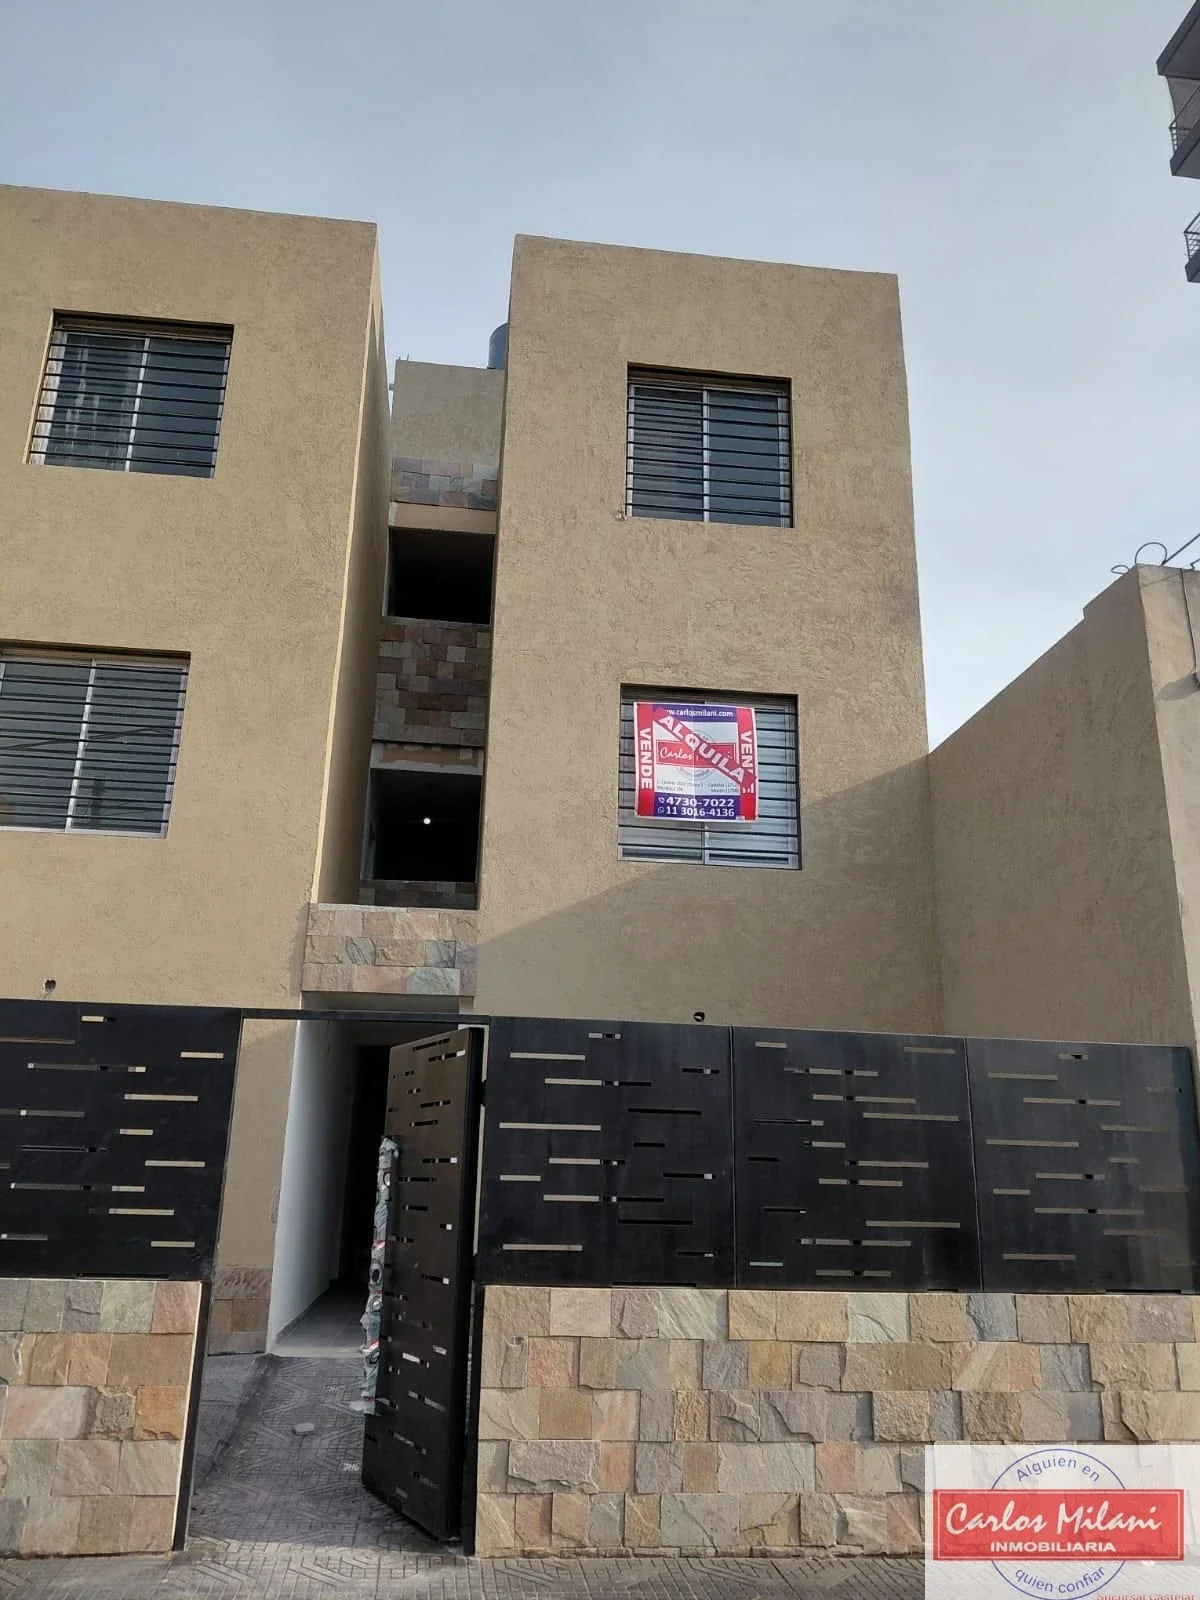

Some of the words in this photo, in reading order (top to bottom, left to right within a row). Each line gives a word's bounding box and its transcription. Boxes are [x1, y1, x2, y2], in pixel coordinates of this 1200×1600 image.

[664, 708, 734, 717] w.carlosmilani.com
[658, 715, 745, 783] ALQUILA
[660, 747, 693, 761] Carlos
[640, 727, 653, 790] VENDE
[740, 730, 755, 794] VENE
[666, 796, 735, 808] 4730-7022
[666, 806, 678, 815] 11
[681, 807, 735, 817] 3016-4136
